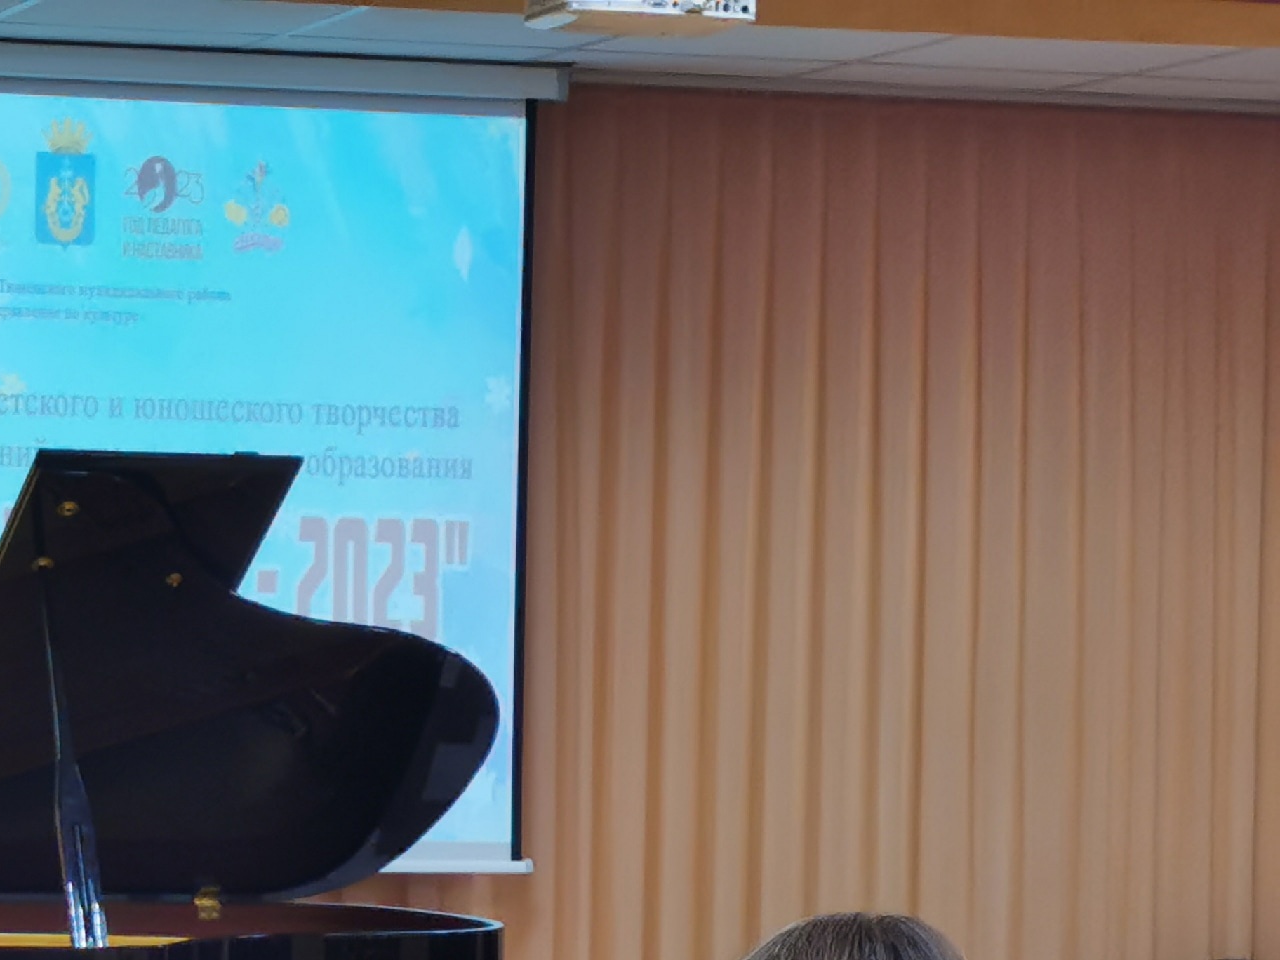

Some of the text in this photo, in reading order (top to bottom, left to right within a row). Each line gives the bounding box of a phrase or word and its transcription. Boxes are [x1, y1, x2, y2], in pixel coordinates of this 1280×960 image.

[108, 399, 122, 418] и
[133, 398, 303, 426] юношеского
[314, 402, 461, 435] творчества
[307, 447, 473, 486] образования
